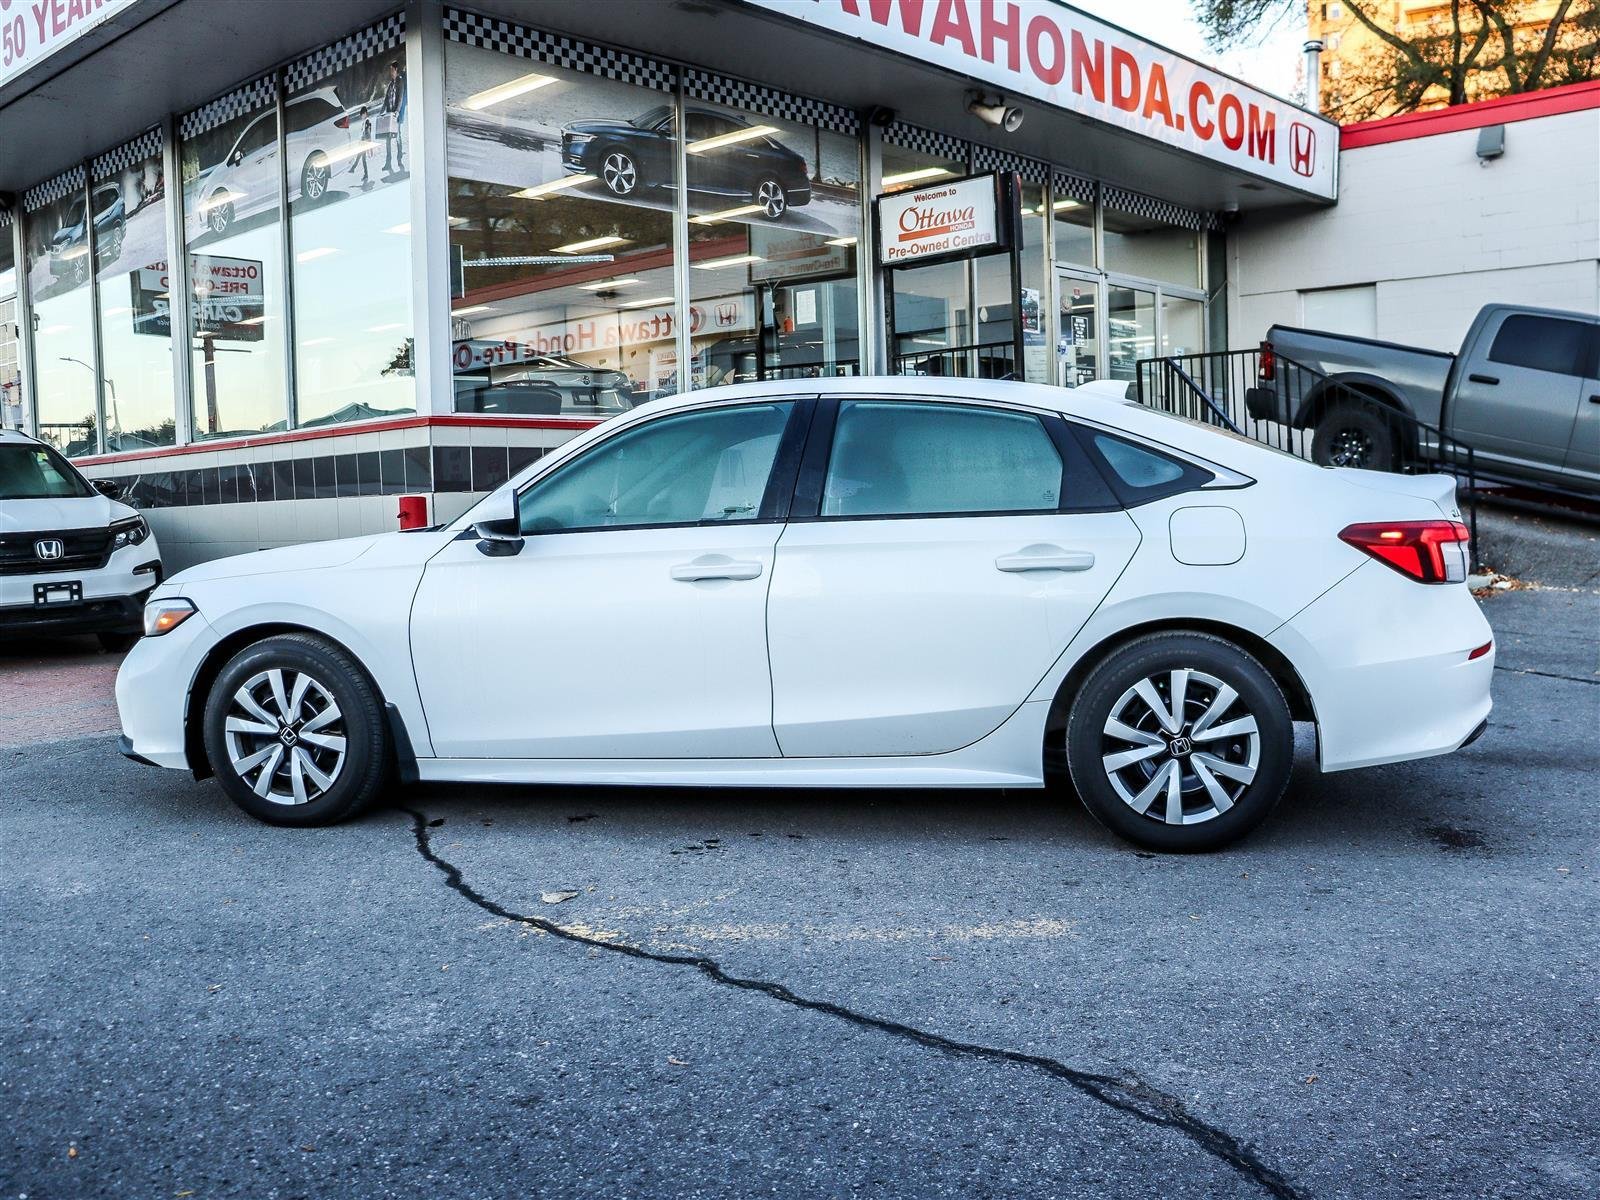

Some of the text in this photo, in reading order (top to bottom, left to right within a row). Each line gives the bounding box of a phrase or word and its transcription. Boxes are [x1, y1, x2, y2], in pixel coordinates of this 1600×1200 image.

[2, 0, 112, 67] 50 YEA
[838, 0, 1276, 166] AHONDA.COM
[914, 187, 957, 203] Welcome to
[898, 205, 975, 233] Ottawa
[949, 221, 974, 232] HONDA
[888, 238, 950, 259] Pre-Owned
